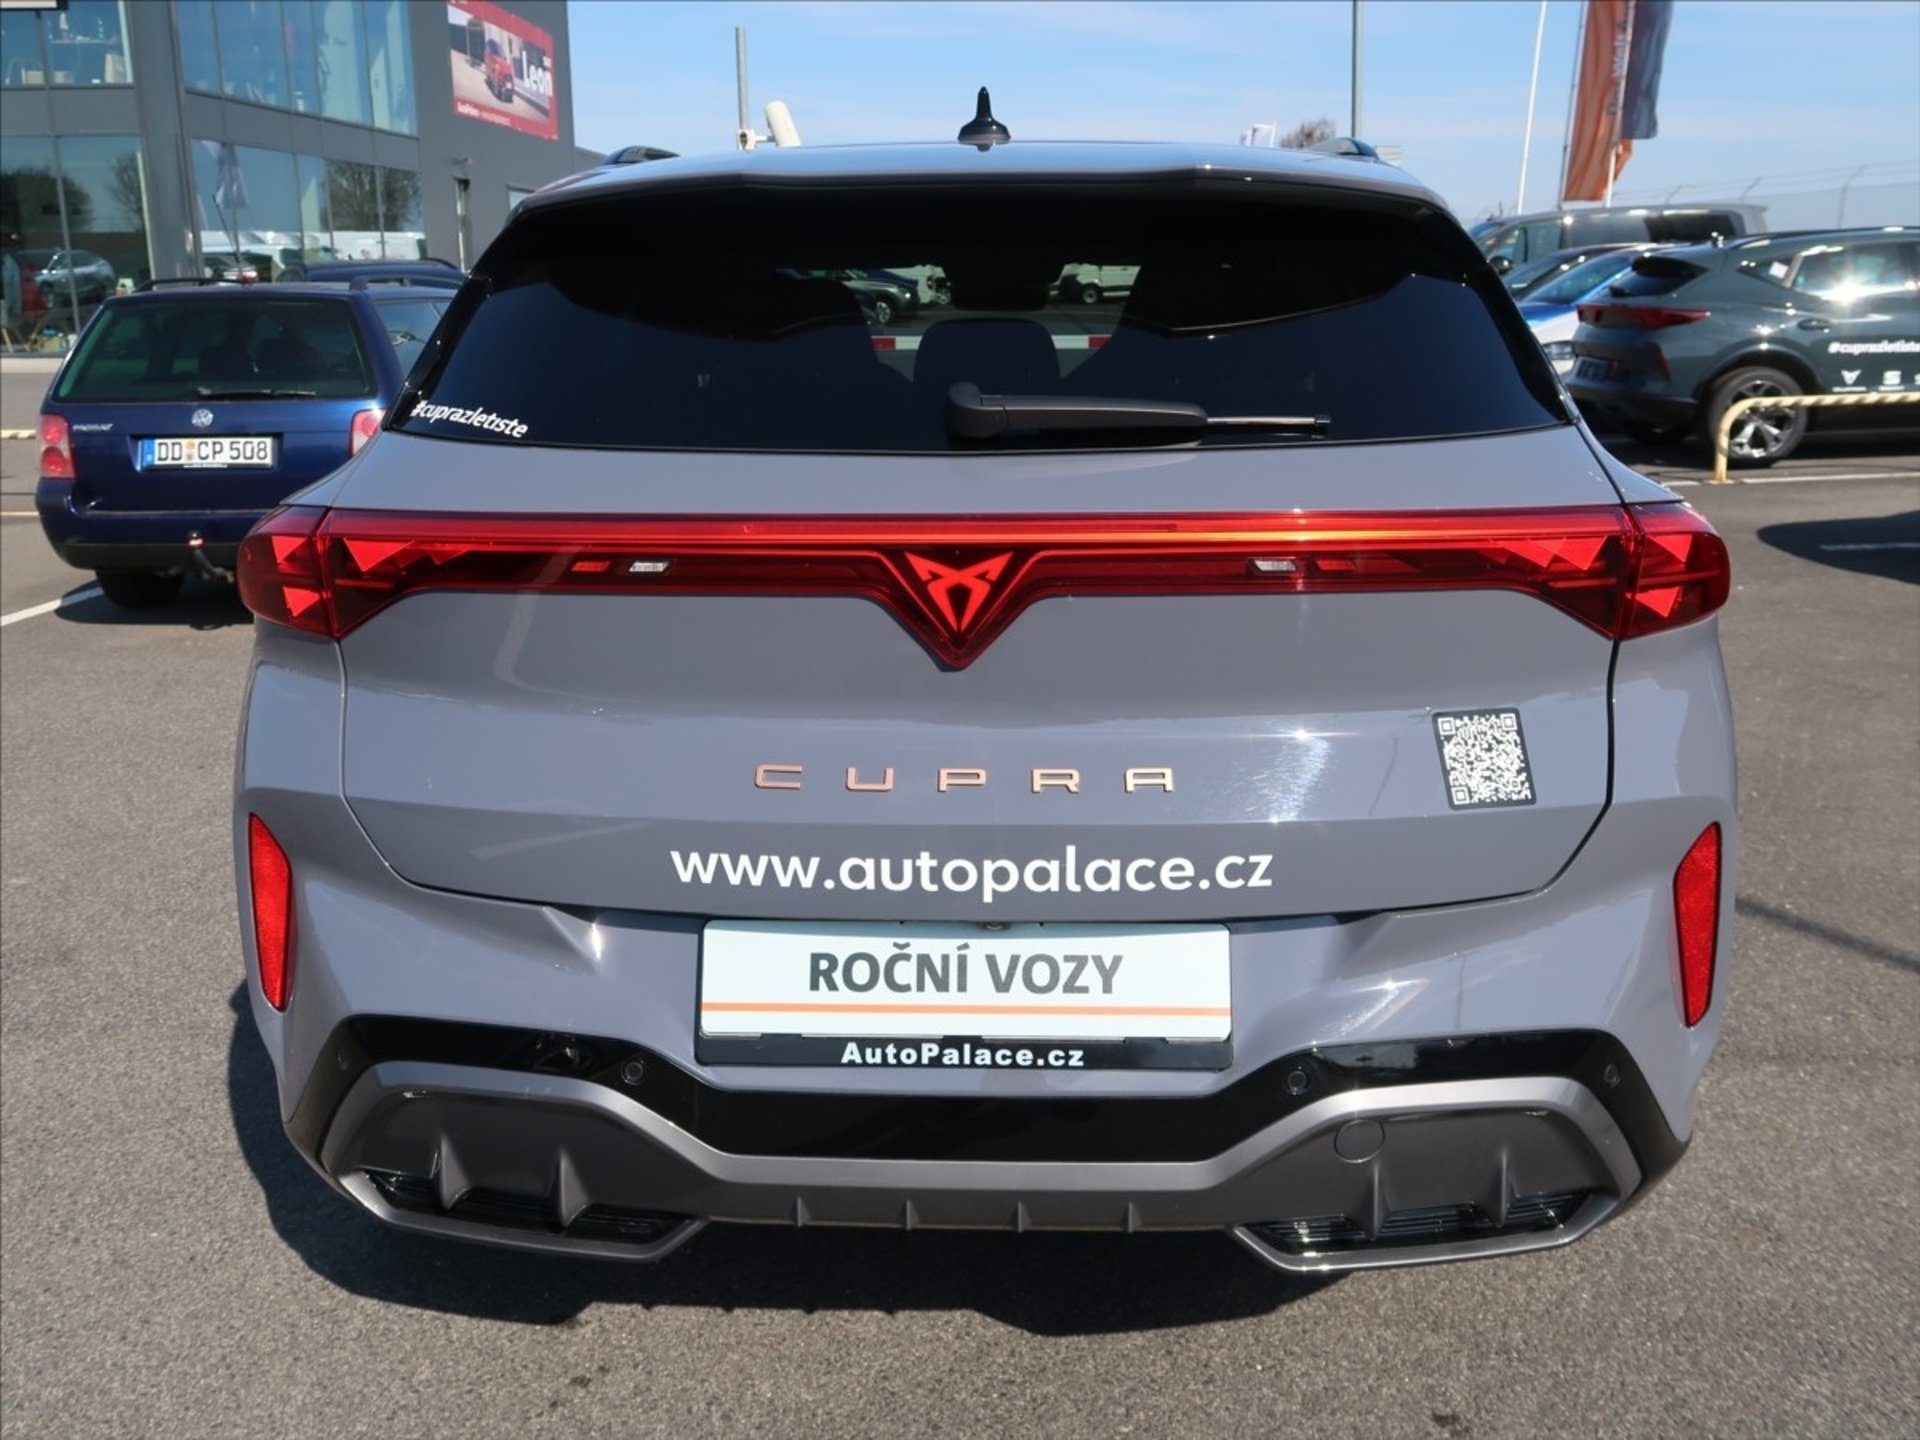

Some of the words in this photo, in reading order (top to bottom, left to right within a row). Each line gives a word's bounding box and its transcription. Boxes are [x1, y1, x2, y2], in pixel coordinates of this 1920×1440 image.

[157, 441, 183, 462] DD
[198, 440, 224, 461] CP
[229, 440, 268, 460] 508
[753, 763, 1174, 794] CUPRA
[670, 845, 1274, 903] www.autopalace.cz
[808, 941, 971, 993] ROČNÍ
[985, 953, 1124, 995] VOZY
[840, 1041, 1086, 1069] AutoPalace.cz
